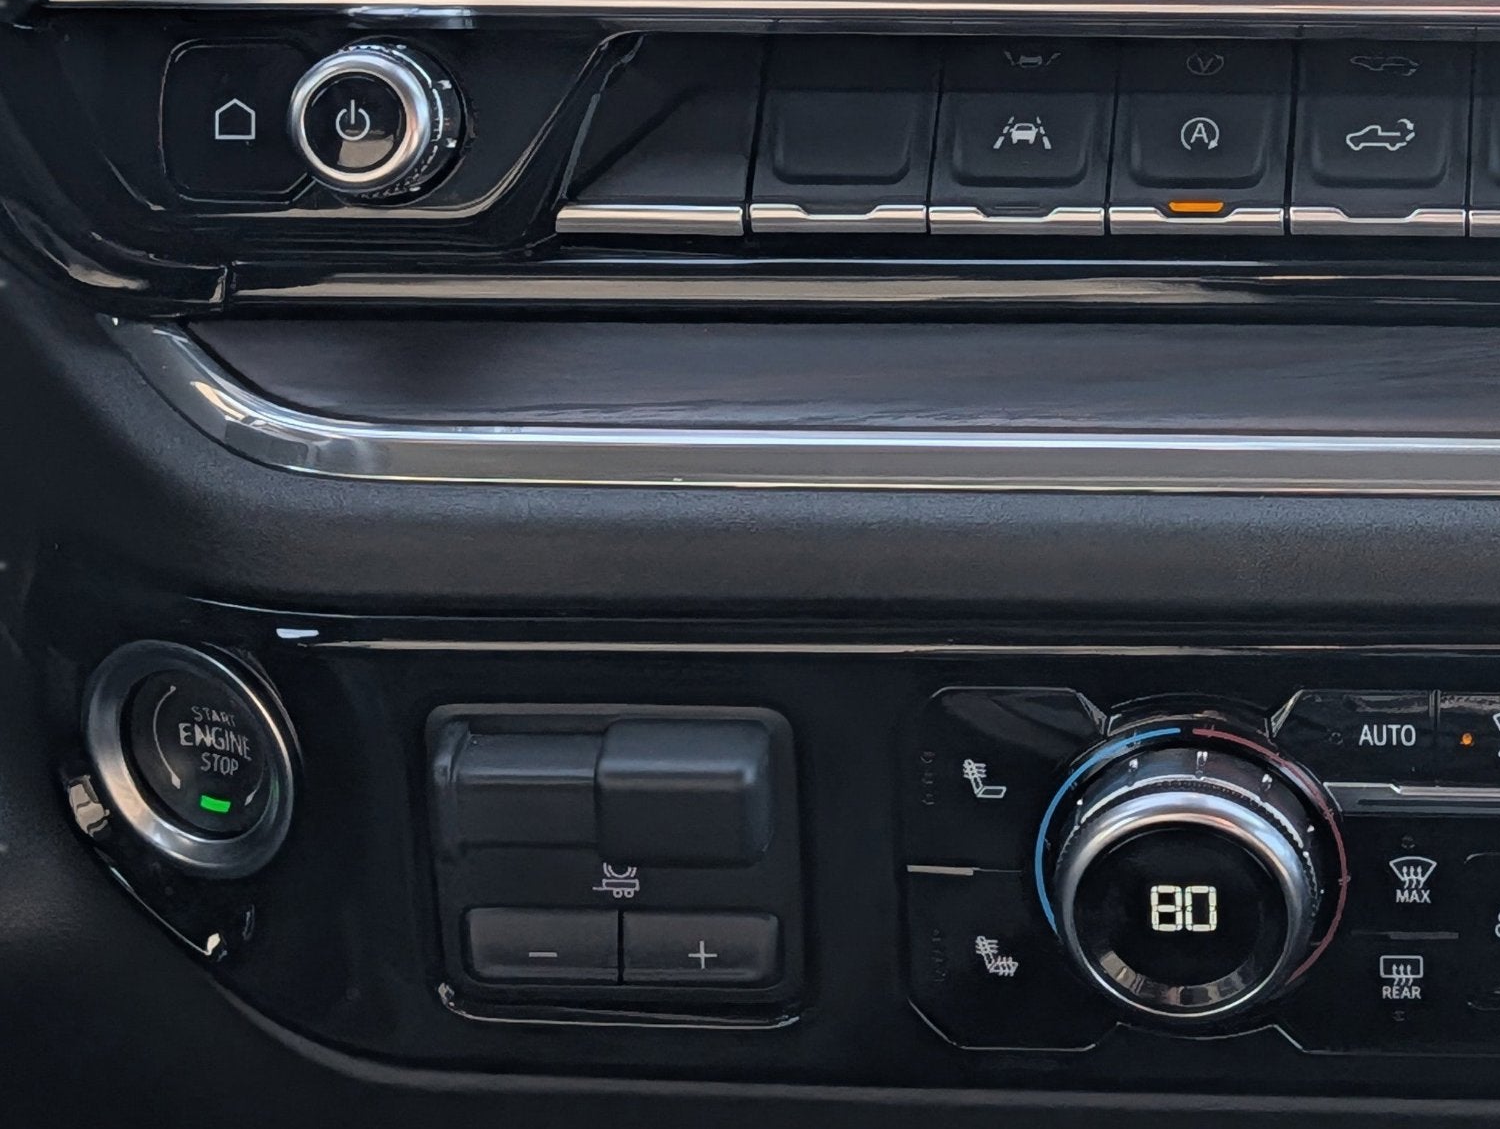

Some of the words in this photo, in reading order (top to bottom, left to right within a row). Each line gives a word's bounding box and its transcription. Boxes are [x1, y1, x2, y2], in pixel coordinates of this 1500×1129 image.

[190, 705, 237, 728] START
[178, 722, 253, 762] ENGINE
[1358, 724, 1417, 747] AUTO
[200, 751, 239, 776] STOP
[1395, 889, 1432, 904] MAX
[1150, 885, 1218, 932] 80
[1381, 985, 1422, 1000] REAR
